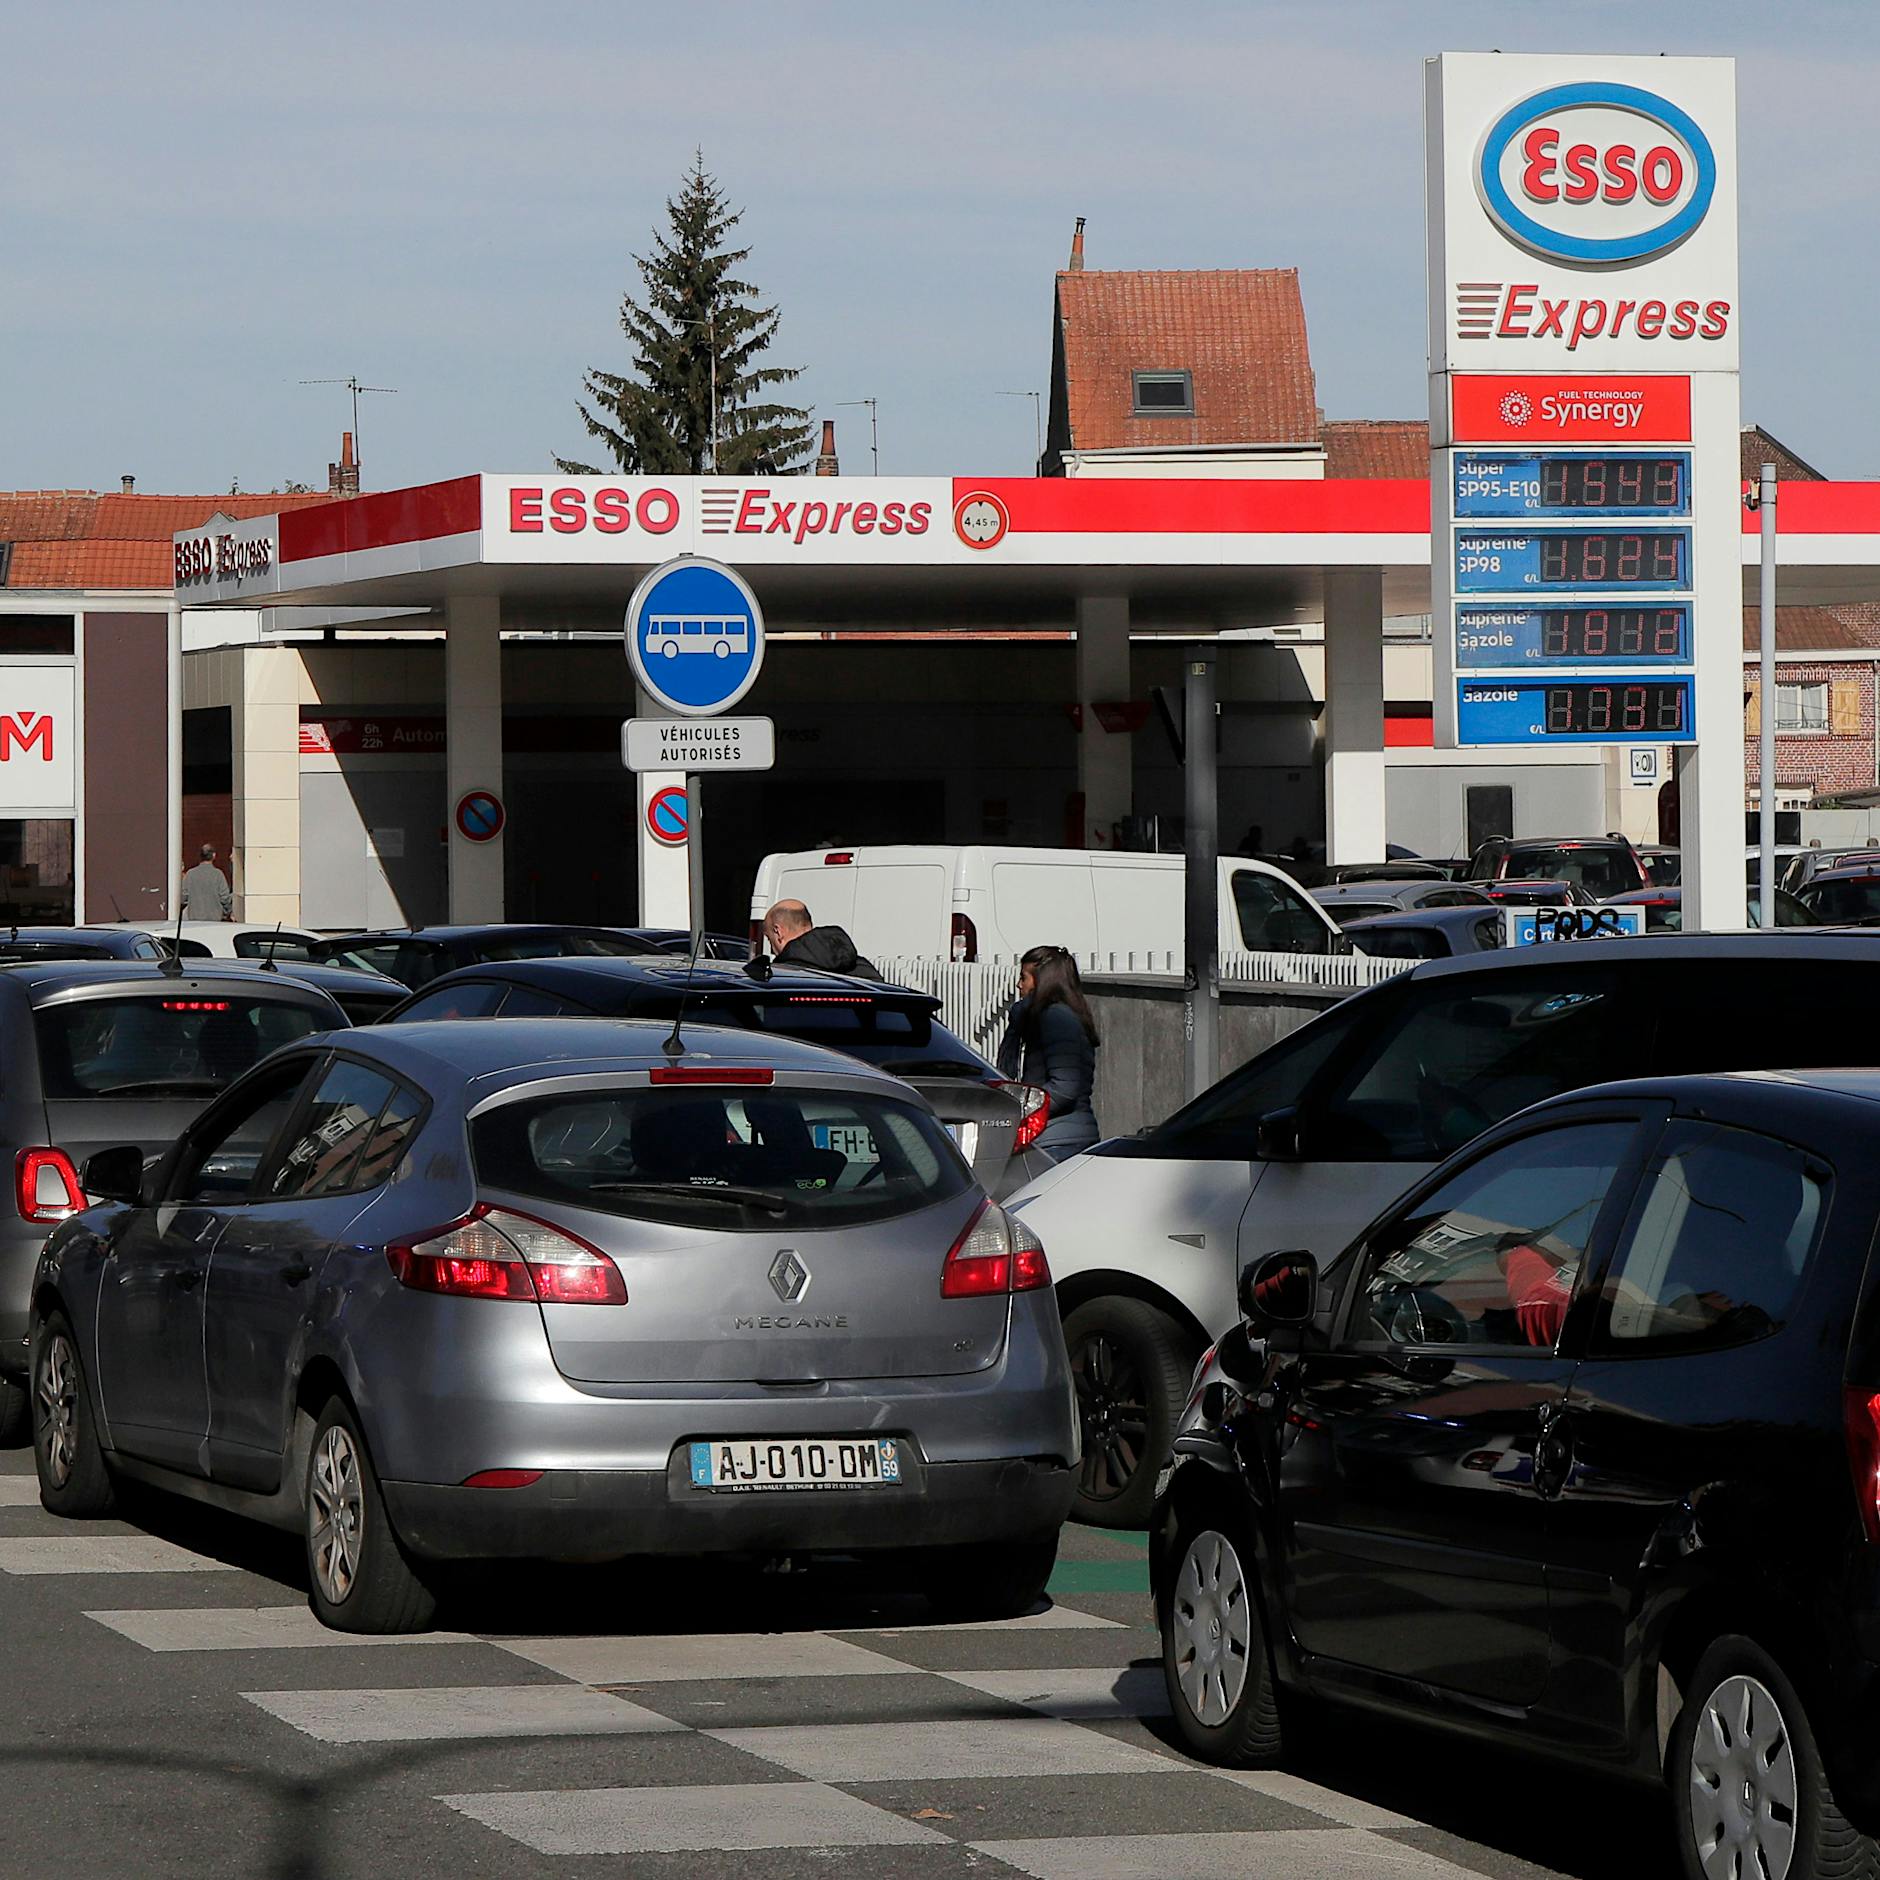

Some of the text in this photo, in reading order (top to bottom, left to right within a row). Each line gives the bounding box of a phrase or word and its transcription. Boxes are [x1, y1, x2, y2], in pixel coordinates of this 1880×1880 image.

[1523, 128, 1684, 204] Esso
[1497, 283, 1731, 351] Express
[1558, 390, 1643, 400] FUEL TECHNOLOGY
[1541, 396, 1644, 428] Synergy
[1459, 480, 1541, 498] SP95-E10
[509, 487, 932, 545] ESSO Express
[175, 534, 273, 580] ESSO Express
[1459, 556, 1501, 573] SP98
[364, 723, 380, 735] 6h
[660, 725, 740, 742] VÉHICULES
[361, 737, 384, 749] 22h
[660, 744, 741, 761] AUTORISÉS
[735, 1315, 849, 1330] MEGANE
[719, 1444, 878, 1480] AJ-010-DM
[881, 1460, 899, 1477] 59
[697, 1469, 706, 1480] F
